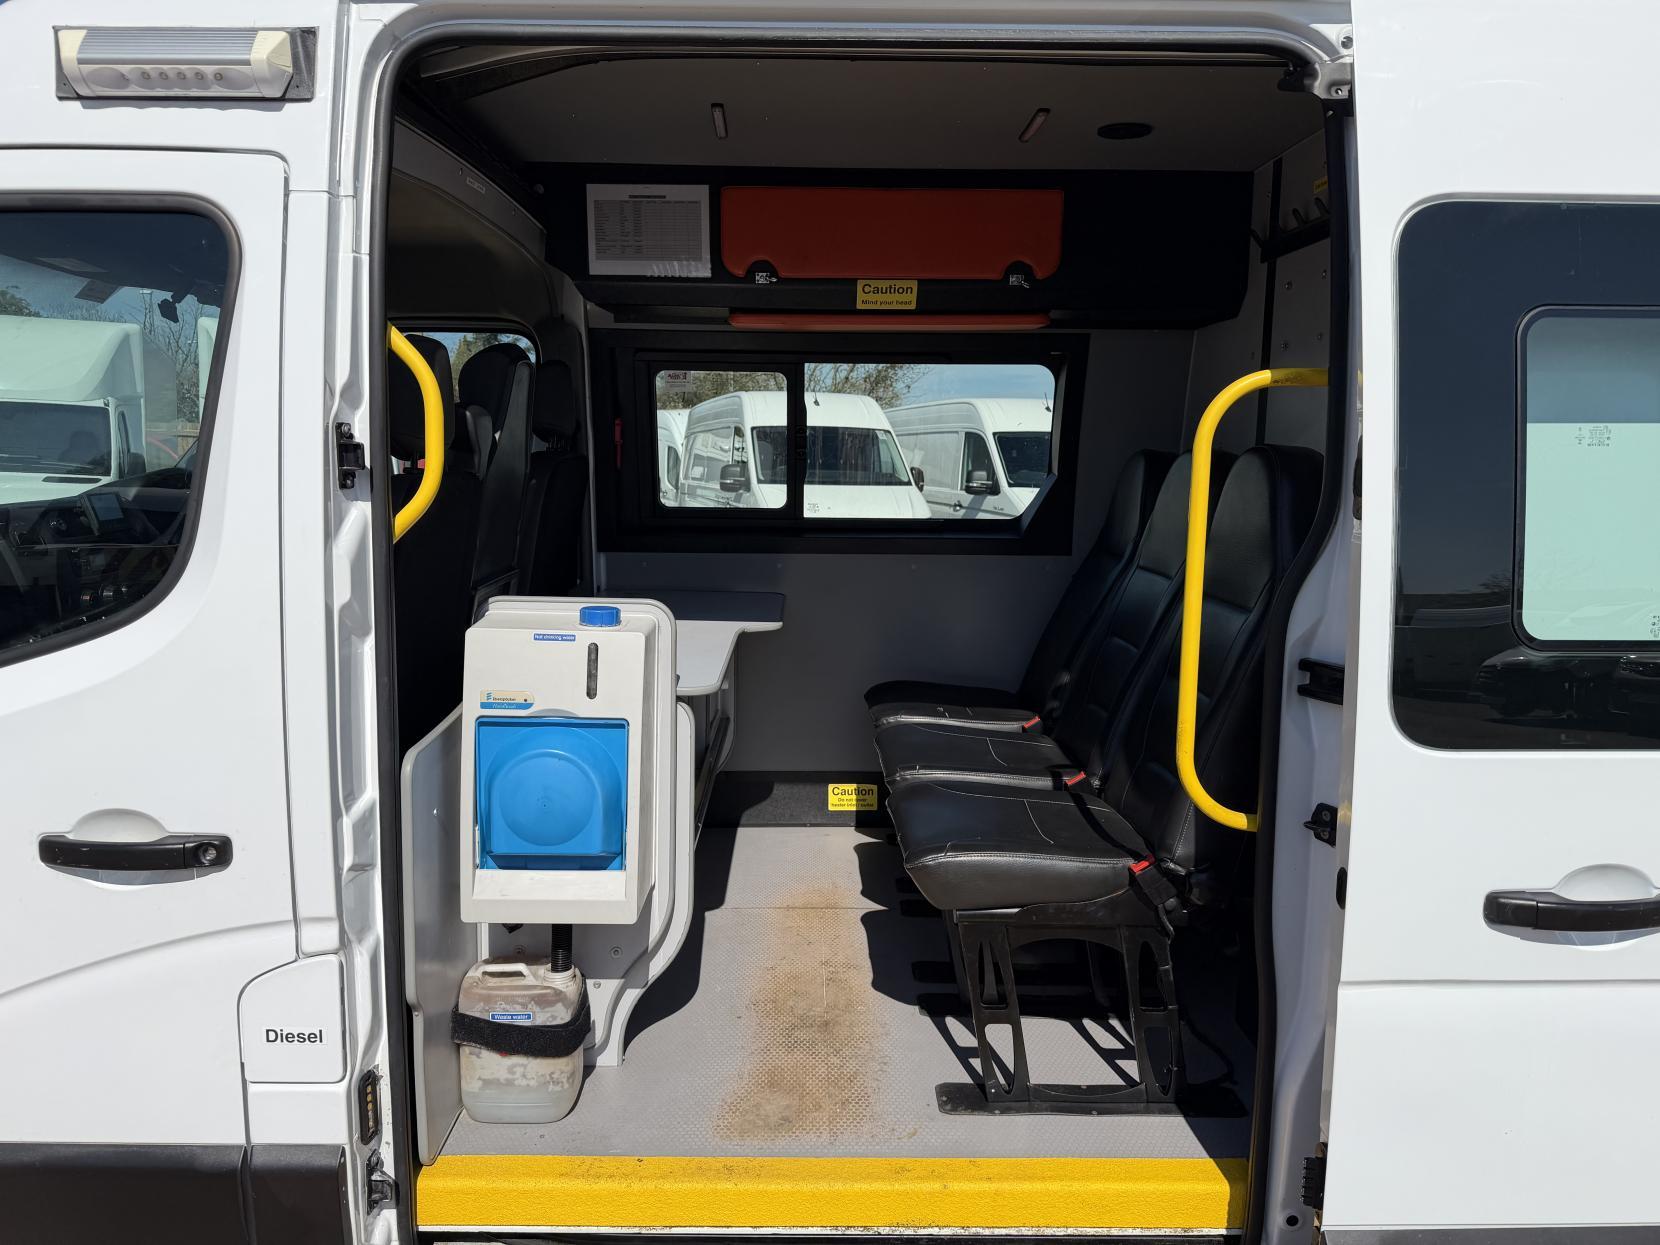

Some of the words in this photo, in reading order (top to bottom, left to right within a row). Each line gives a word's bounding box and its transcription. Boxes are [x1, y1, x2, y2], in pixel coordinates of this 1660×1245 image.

[861, 283, 913, 295] Caution
[543, 633, 562, 641] drinking
[832, 786, 874, 796] Caution
[265, 1028, 323, 1043] Diesel
